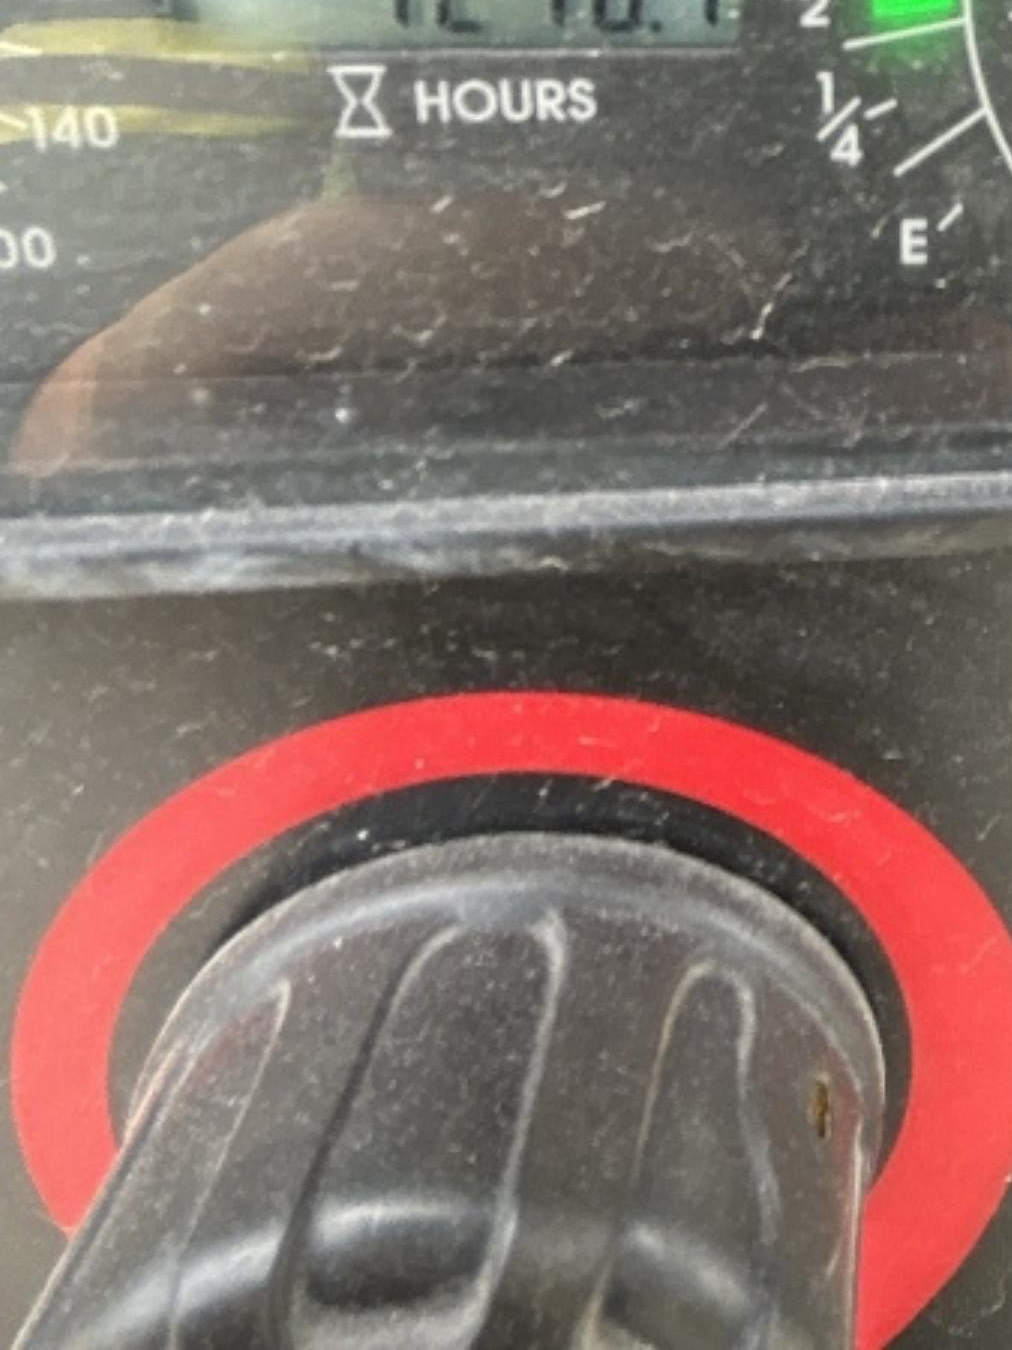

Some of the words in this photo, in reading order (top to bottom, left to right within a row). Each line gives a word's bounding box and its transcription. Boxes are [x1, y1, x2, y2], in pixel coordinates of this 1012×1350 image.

[415, 78, 598, 123] HOURS
[26, 106, 118, 150] 140
[900, 219, 928, 265] E
